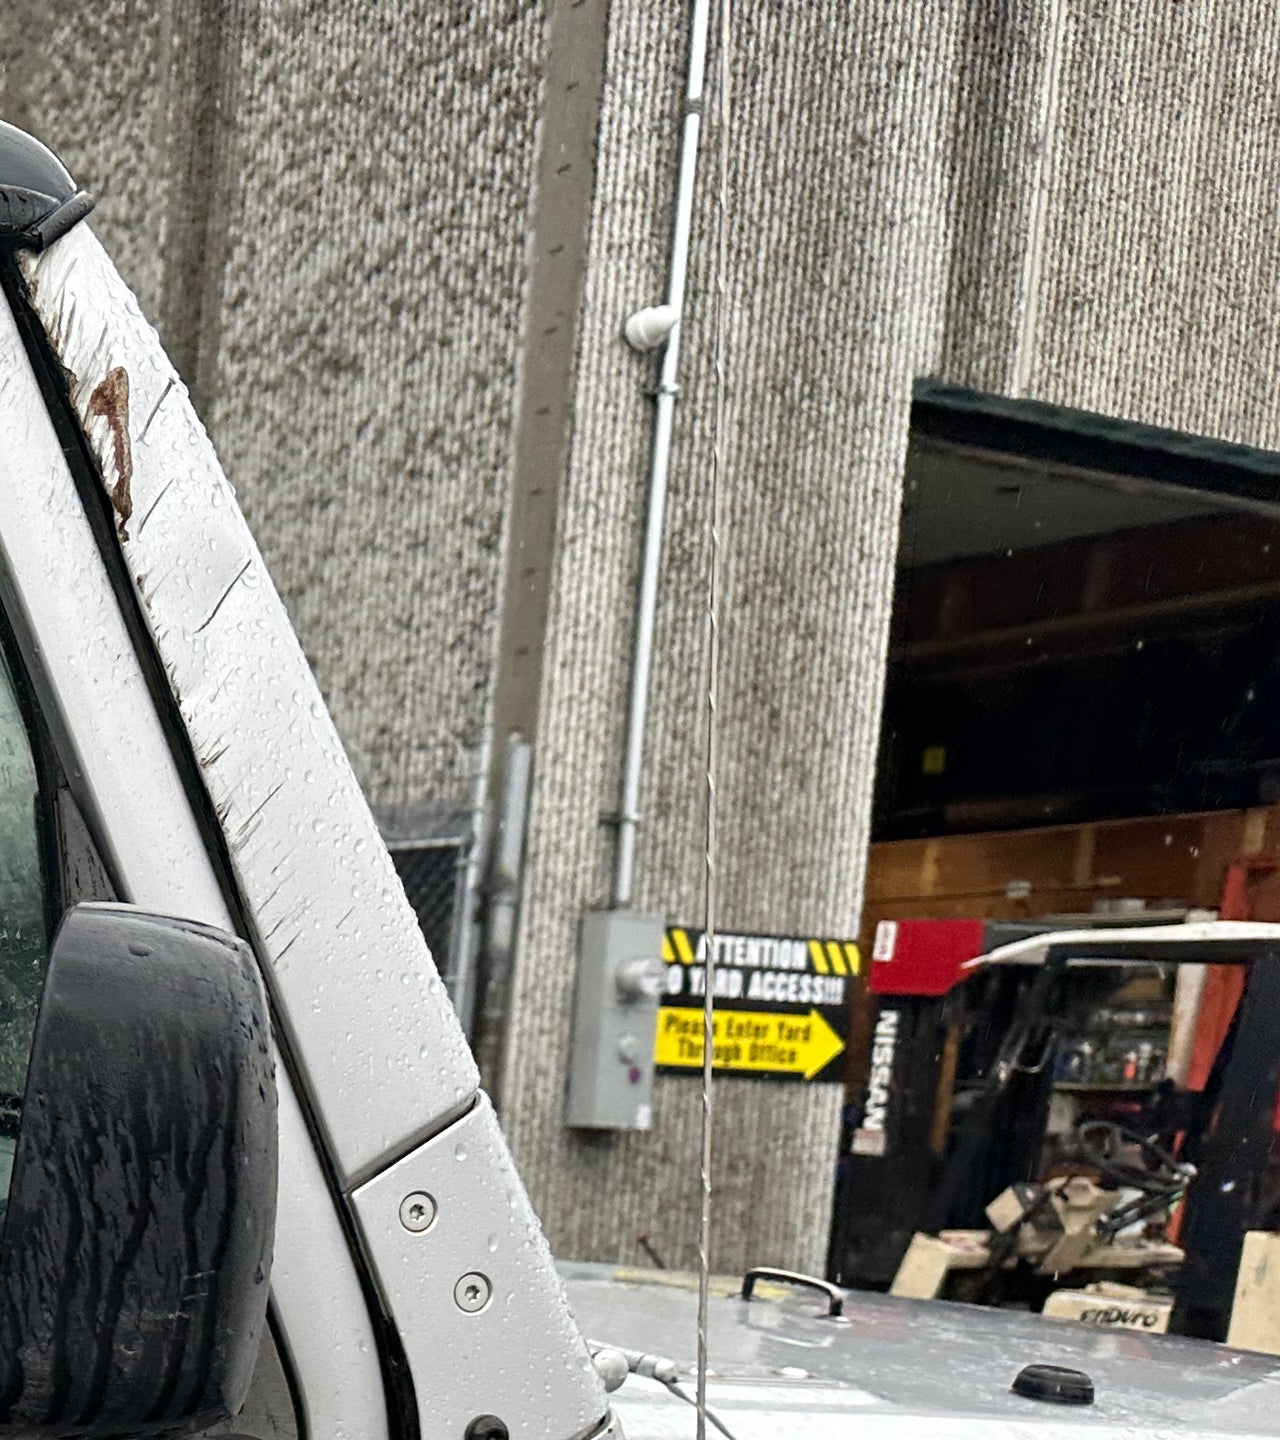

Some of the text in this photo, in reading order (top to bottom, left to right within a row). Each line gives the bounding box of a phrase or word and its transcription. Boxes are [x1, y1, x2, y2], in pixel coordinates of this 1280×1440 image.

[696, 932, 808, 971] ATTENTION
[664, 1012, 718, 1037] Pleae
[678, 1036, 742, 1067] Thrugh
[862, 1009, 899, 1131] NISSAN
